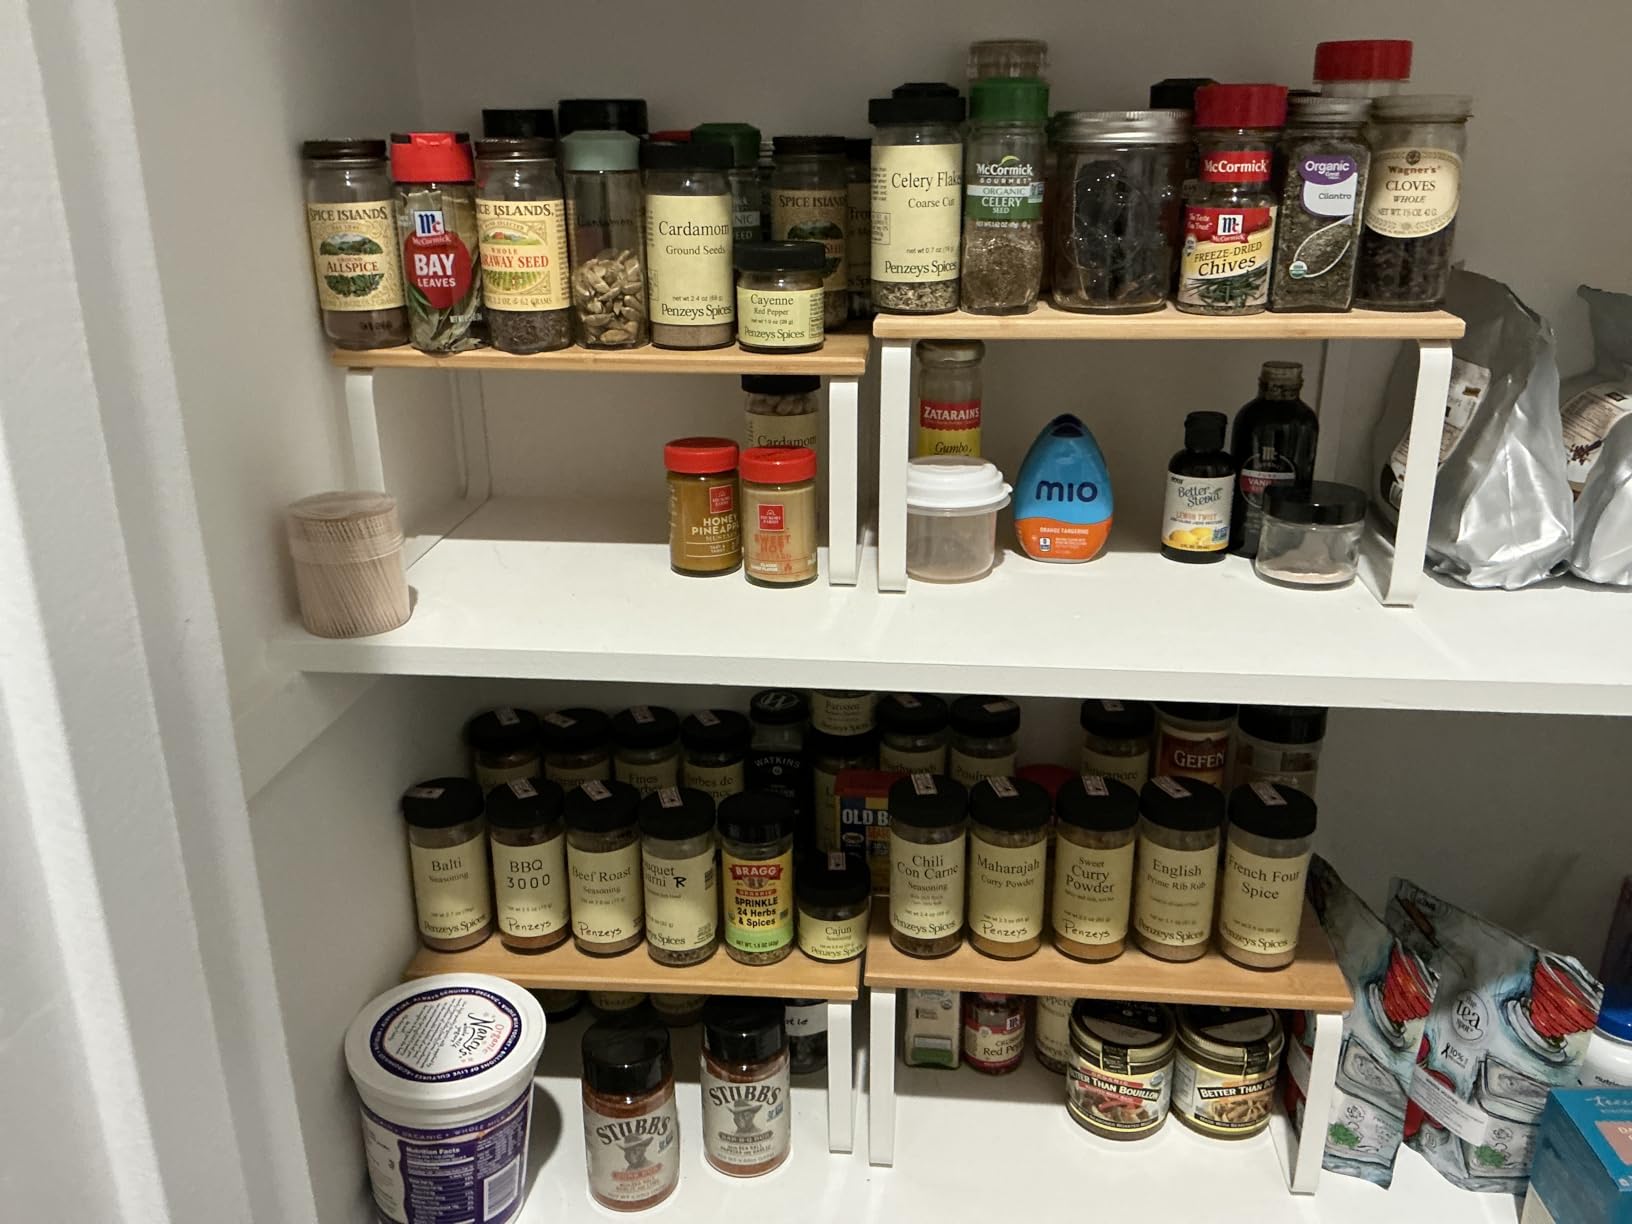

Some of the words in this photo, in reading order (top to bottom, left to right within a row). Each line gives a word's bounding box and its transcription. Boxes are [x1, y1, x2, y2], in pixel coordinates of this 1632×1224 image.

[976, 163, 1034, 176] McCormick
[1204, 159, 1267, 173] McCormick
[1304, 160, 1350, 175] Organic
[891, 172, 934, 192] Celery
[1385, 180, 1436, 192] CLOVES
[982, 187, 1026, 196] ORGANIC
[1318, 192, 1352, 200] Cilantro
[779, 195, 810, 207] SPICE
[908, 198, 940, 209] Coarse
[981, 196, 1023, 207] CELERY
[1393, 195, 1427, 204] WHOLE
[337, 206, 388, 221] ISLANDS
[658, 220, 729, 236] Cardamom
[665, 245, 701, 255] Ground
[703, 245, 726, 255] Seeds
[1194, 241, 1262, 263] FREEZE-DRIED
[327, 261, 379, 273] ALLSPICE
[413, 253, 455, 276] BAY
[518, 255, 549, 268] SEED
[885, 260, 930, 278] Penzeys
[930, 259, 957, 277] Spices
[1198, 255, 1256, 277] Chives
[417, 277, 456, 288] LEAVES
[750, 293, 795, 308] Cayenne
[661, 303, 705, 321] Penzeys
[705, 303, 733, 320] Spices
[766, 308, 789, 317] Pepper
[744, 325, 776, 341] Penzeys
[777, 328, 805, 342] Spices
[1178, 486, 1211, 498] Better
[703, 513, 738, 527] HONEY
[753, 533, 792, 544] SWEET
[753, 755, 801, 769] WATKINS
[1173, 750, 1225, 769] GEFEN
[841, 808, 874, 825] OLD
[431, 856, 462, 872] Balti
[510, 859, 543, 873] BBQ
[912, 855, 944, 868] Chili
[977, 853, 1040, 876] Maharajah
[1079, 856, 1105, 868] Sweet
[1152, 858, 1202, 879] English
[1228, 854, 1267, 882] French
[1272, 871, 1300, 883] Four
[572, 863, 597, 882] Beef
[599, 865, 632, 882] Roast
[735, 866, 777, 876] BRAGG
[896, 861, 920, 879] Con
[924, 864, 959, 880] Carne
[1071, 864, 1110, 884] Curry
[506, 873, 551, 890] 3000
[672, 876, 687, 889] R
[907, 880, 949, 892] Seasoning
[981, 873, 1003, 889] Curry
[1005, 878, 1035, 889] Powder
[1066, 873, 1115, 893] Powder
[1147, 873, 1170, 889] Prime
[1172, 881, 1188, 890] Rib
[1241, 881, 1280, 900] Spice
[735, 896, 779, 908] SPRINKLE
[737, 907, 748, 916] 24
[750, 907, 777, 918] Herbs
[424, 919, 460, 936] Penzeys
[459, 912, 487, 932] Spices
[505, 916, 552, 932] Penzeys
[577, 920, 623, 939] Penzeys
[738, 917, 744, 925] &
[746, 918, 776, 929] Spices
[893, 911, 927, 935] Penzeys
[928, 919, 956, 935] Spices
[979, 919, 1028, 939] Penzeys
[1062, 918, 1111, 941] Penzeys
[1138, 917, 1175, 941] Penzeys
[1175, 930, 1204, 943] Spices
[825, 926, 852, 936] Cajun
[657, 932, 686, 946] Spices
[1257, 937, 1289, 951] Spices
[1456, 1000, 1481, 1030] tea
[458, 1012, 496, 1058] Nancy's
[983, 1047, 1003, 1057] Red
[452, 1069, 470, 1078] LIVE
[708, 1084, 782, 1106] STUBB'S
[1091, 1077, 1117, 1092] THAN
[1118, 1085, 1159, 1100] BOUILLON
[1200, 1088, 1236, 1099] BETTER
[1238, 1083, 1263, 1094] THAN
